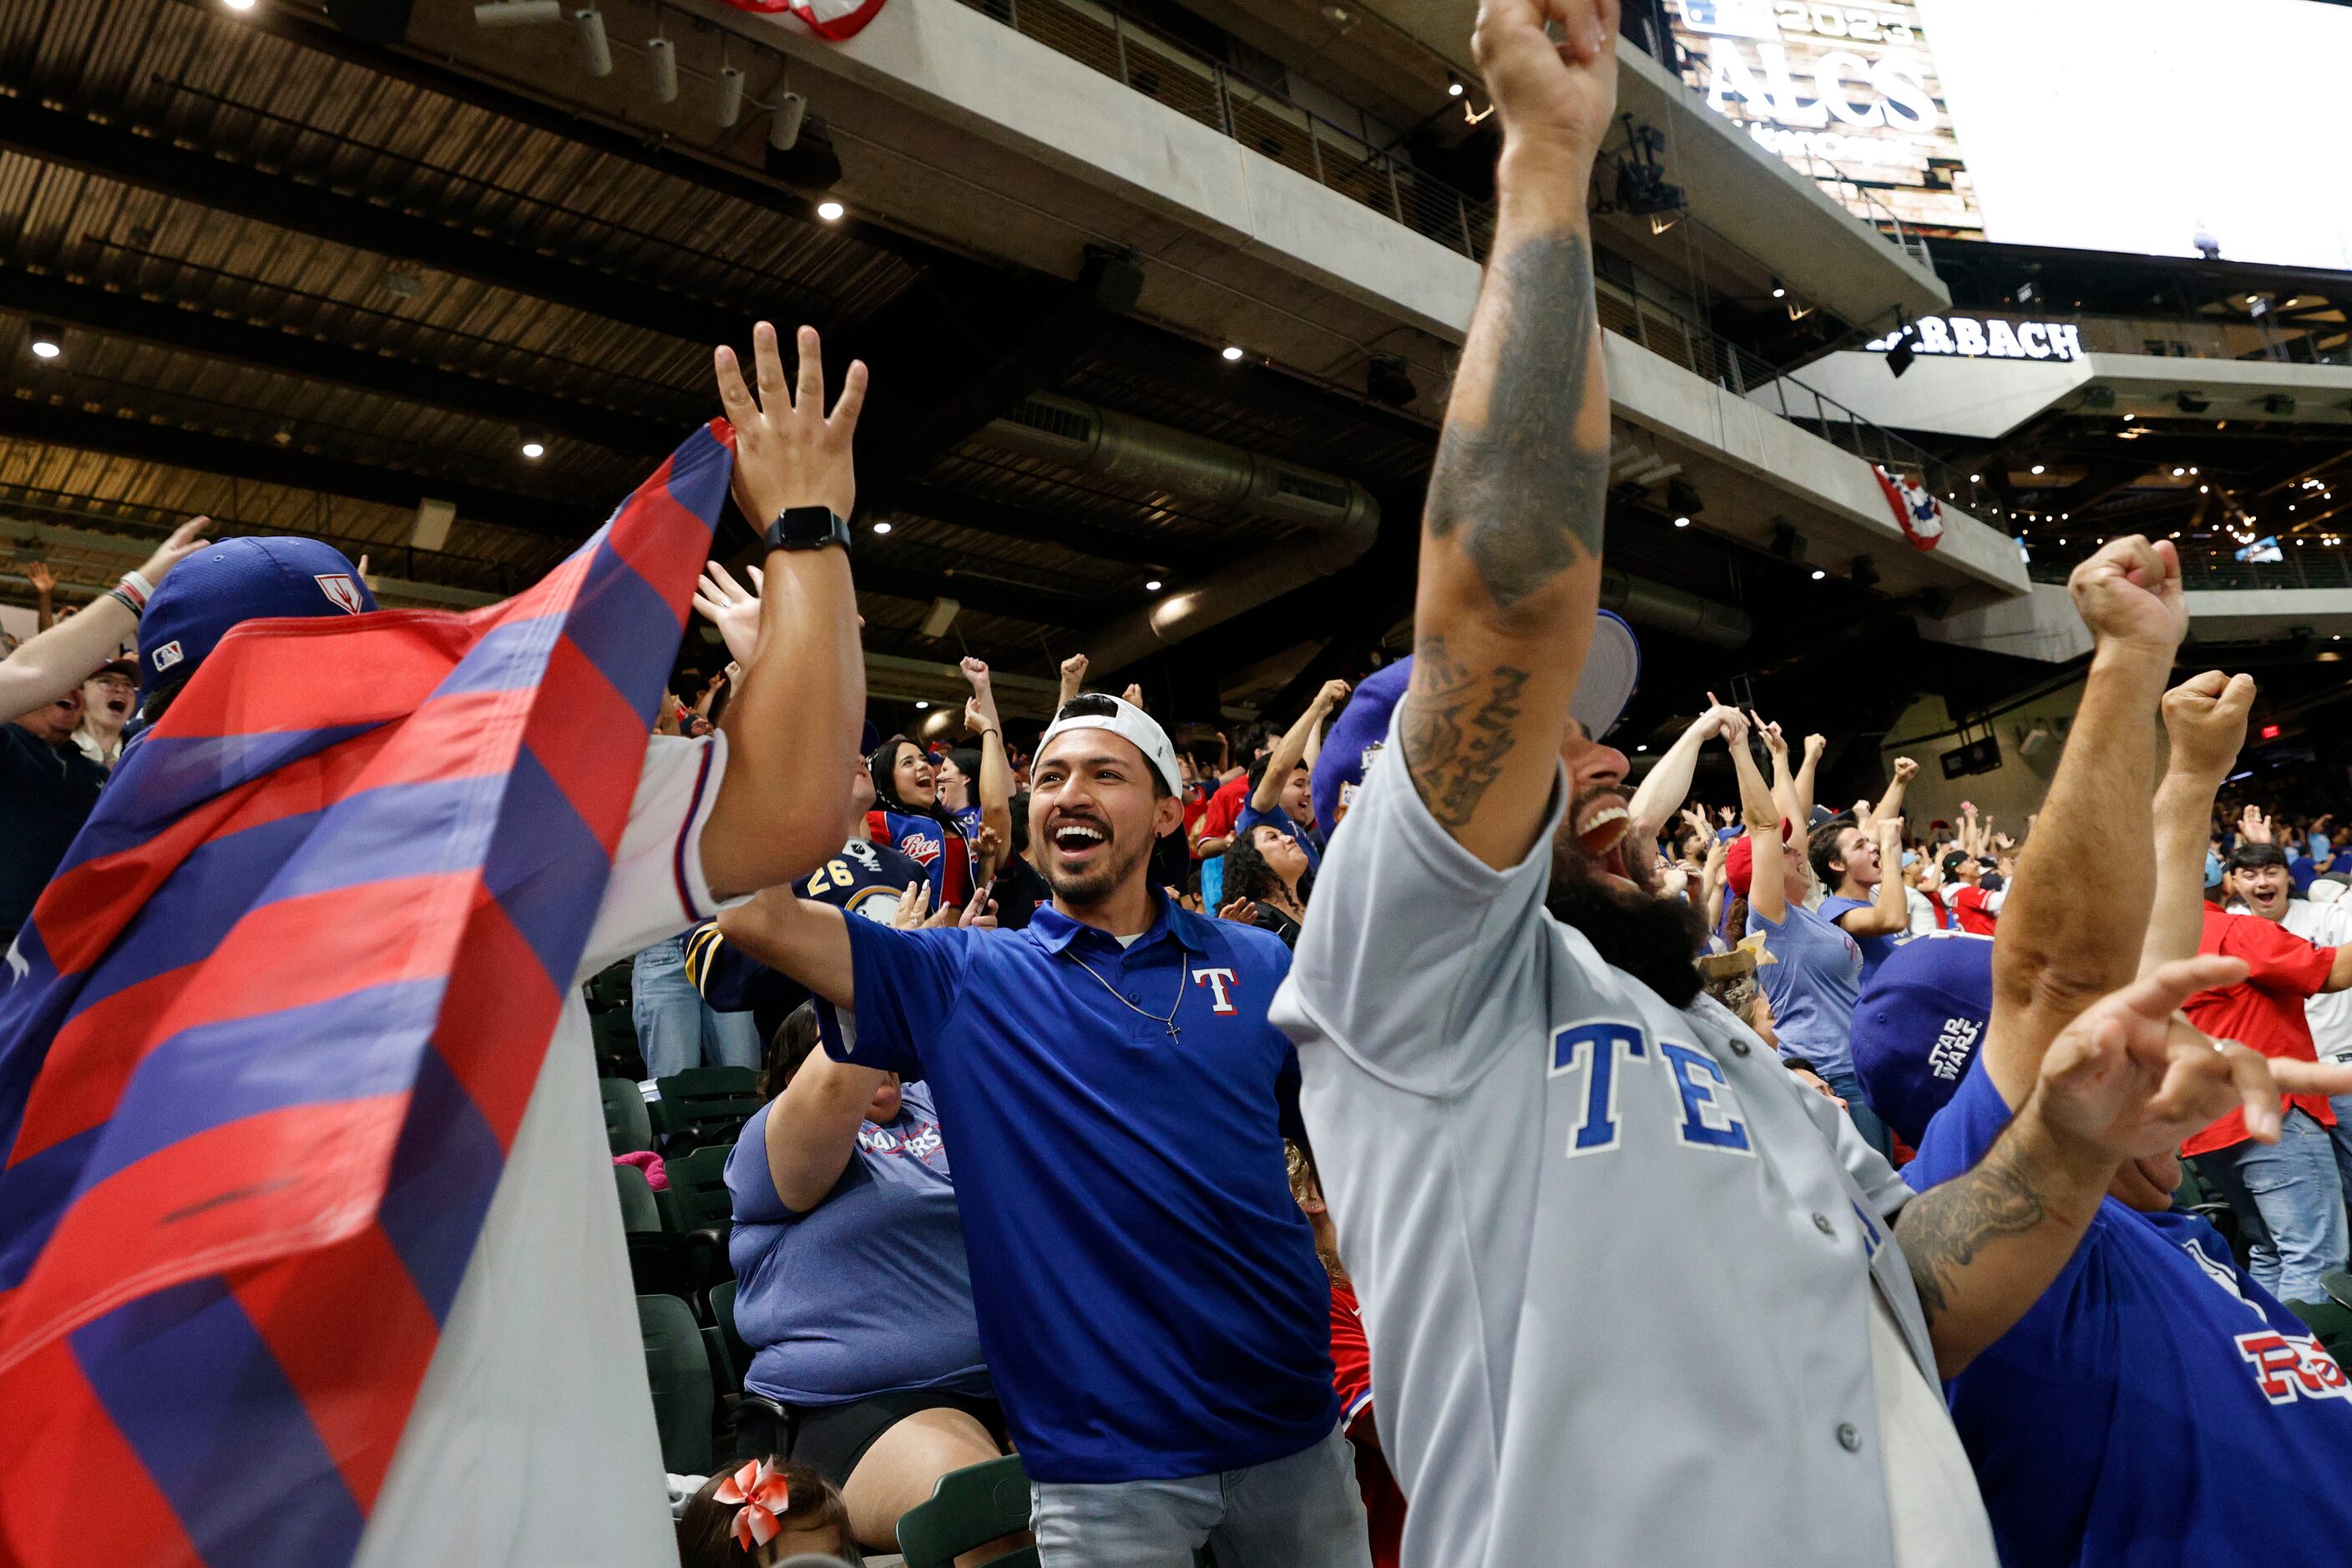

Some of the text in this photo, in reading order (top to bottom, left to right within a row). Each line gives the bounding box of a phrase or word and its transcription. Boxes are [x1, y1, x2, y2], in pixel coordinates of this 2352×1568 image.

[1776, 1, 1914, 44] 2023
[1707, 37, 1939, 133] ALCS
[1191, 968, 1240, 1015] T
[1928, 1018, 1965, 1077] STAR
[1940, 1020, 1978, 1080] WARS
